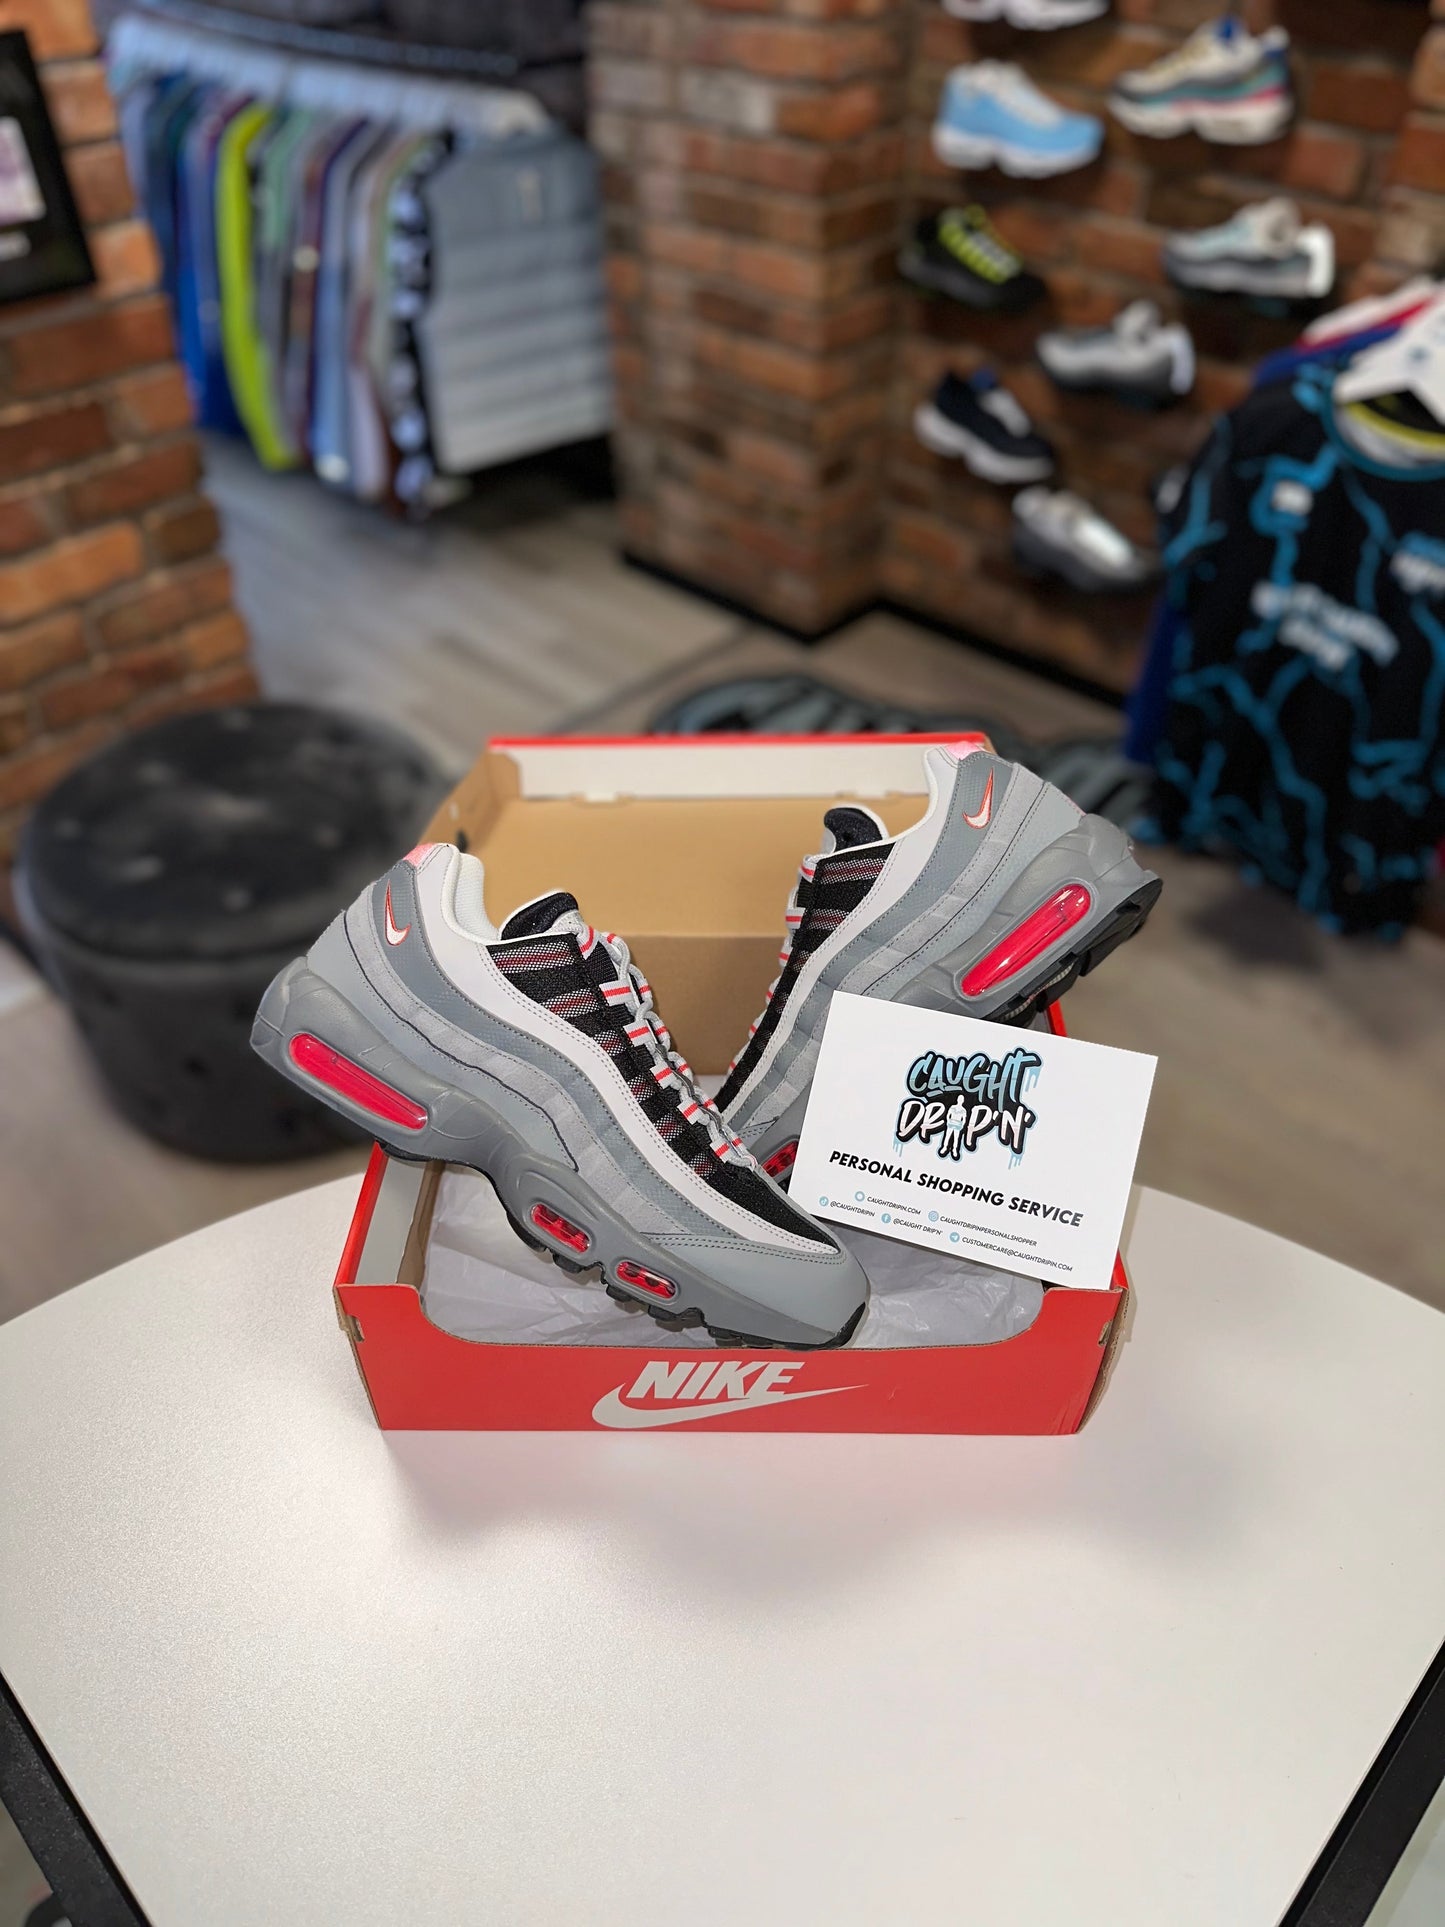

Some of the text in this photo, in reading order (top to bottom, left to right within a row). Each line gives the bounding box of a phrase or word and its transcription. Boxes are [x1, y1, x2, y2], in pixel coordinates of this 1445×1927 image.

[908, 1049, 1040, 1113] CAUGHT
[829, 1150, 1084, 1228] PERSONAL SHOPPING SERVICE
[866, 1196, 921, 1215] CAUGHTDRIPIN.COM
[829, 1200, 876, 1217] @CAUGHTDRIPIN
[892, 1218, 922, 1231] @CAUGHT
[939, 1215, 1038, 1247] CAUGHTDRIPINPERSONALSHOPPER
[961, 1236, 1073, 1272] CUSTOMERCARE@CAUGHTDRIPIN.COM
[626, 1361, 805, 1400] NIKE
